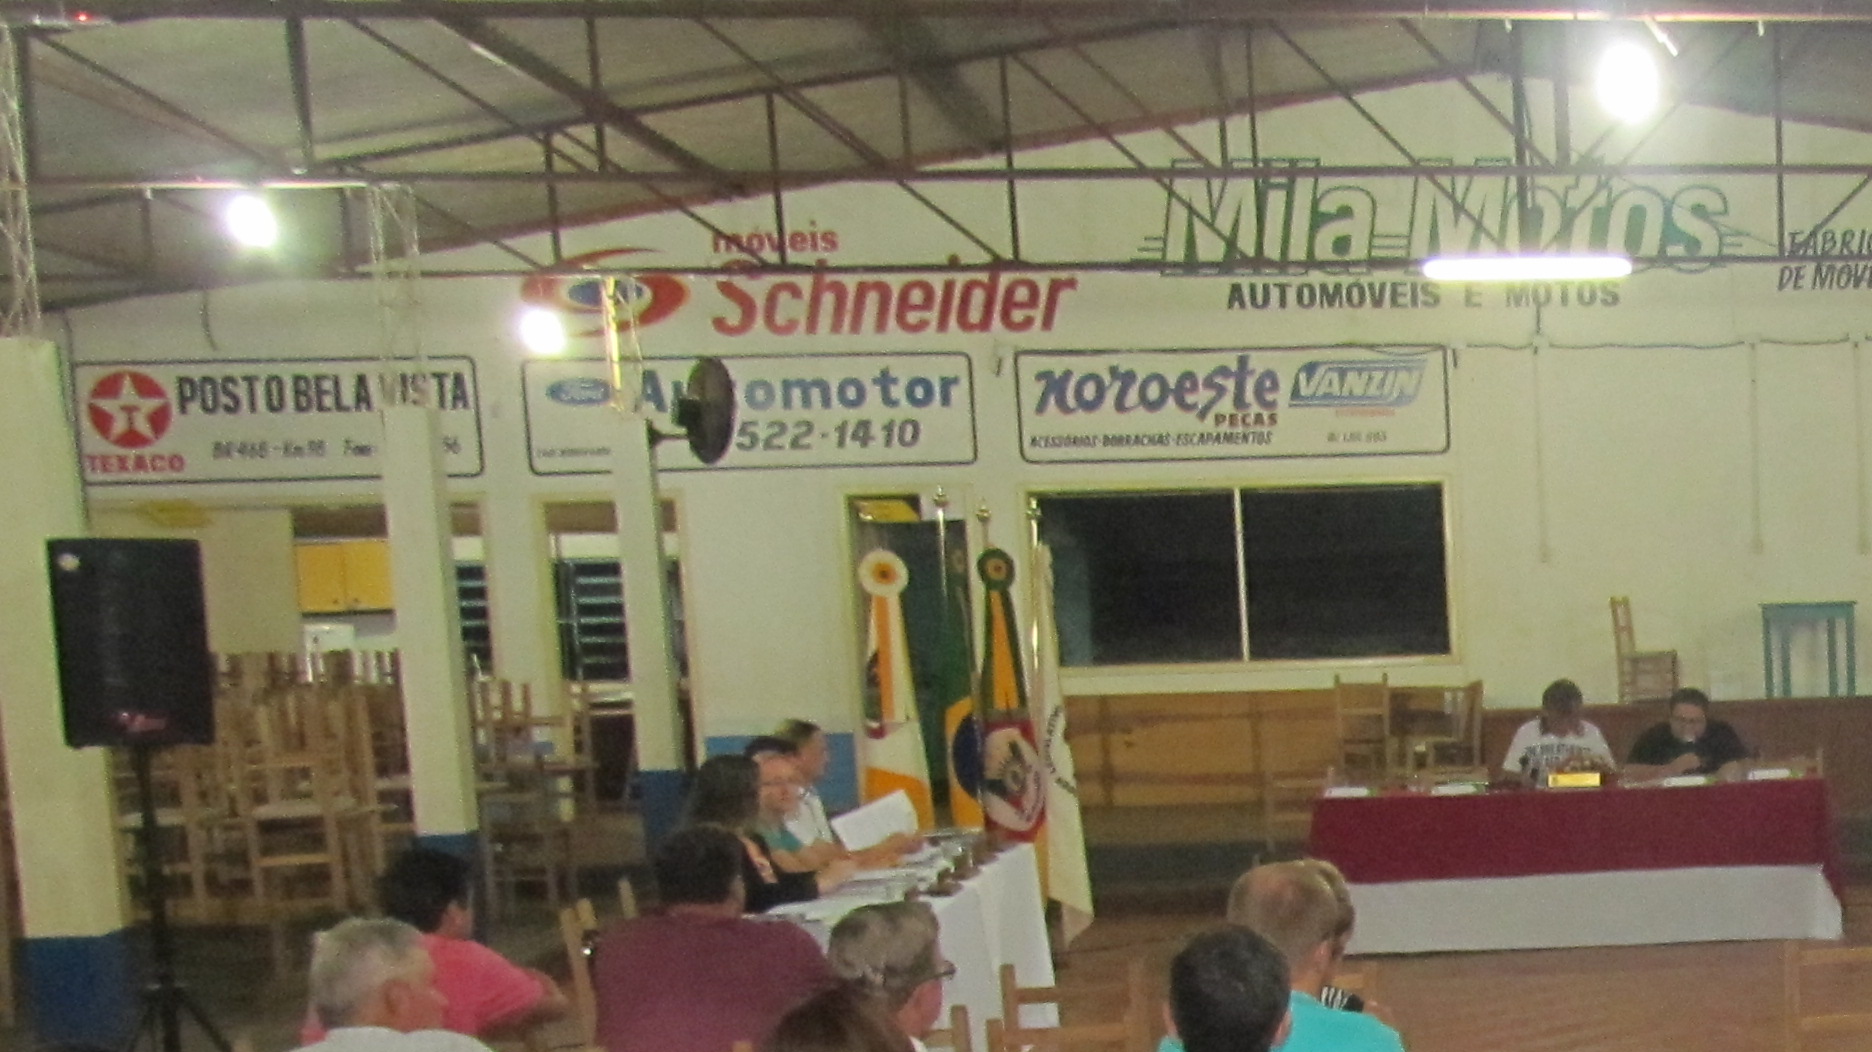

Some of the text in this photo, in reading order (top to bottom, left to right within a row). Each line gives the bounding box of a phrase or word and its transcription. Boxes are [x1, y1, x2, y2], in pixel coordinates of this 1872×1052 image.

[711, 254, 1079, 338] Schneider
[1227, 279, 1621, 311] AUTOMÓVEIS E MOTOS
[1778, 264, 1806, 292] DE
[176, 374, 286, 416] POSTO
[292, 373, 374, 413] BELA
[634, 368, 960, 413] Aomotor
[1295, 362, 1425, 401] VANZIN
[84, 453, 186, 474] TEXACO
